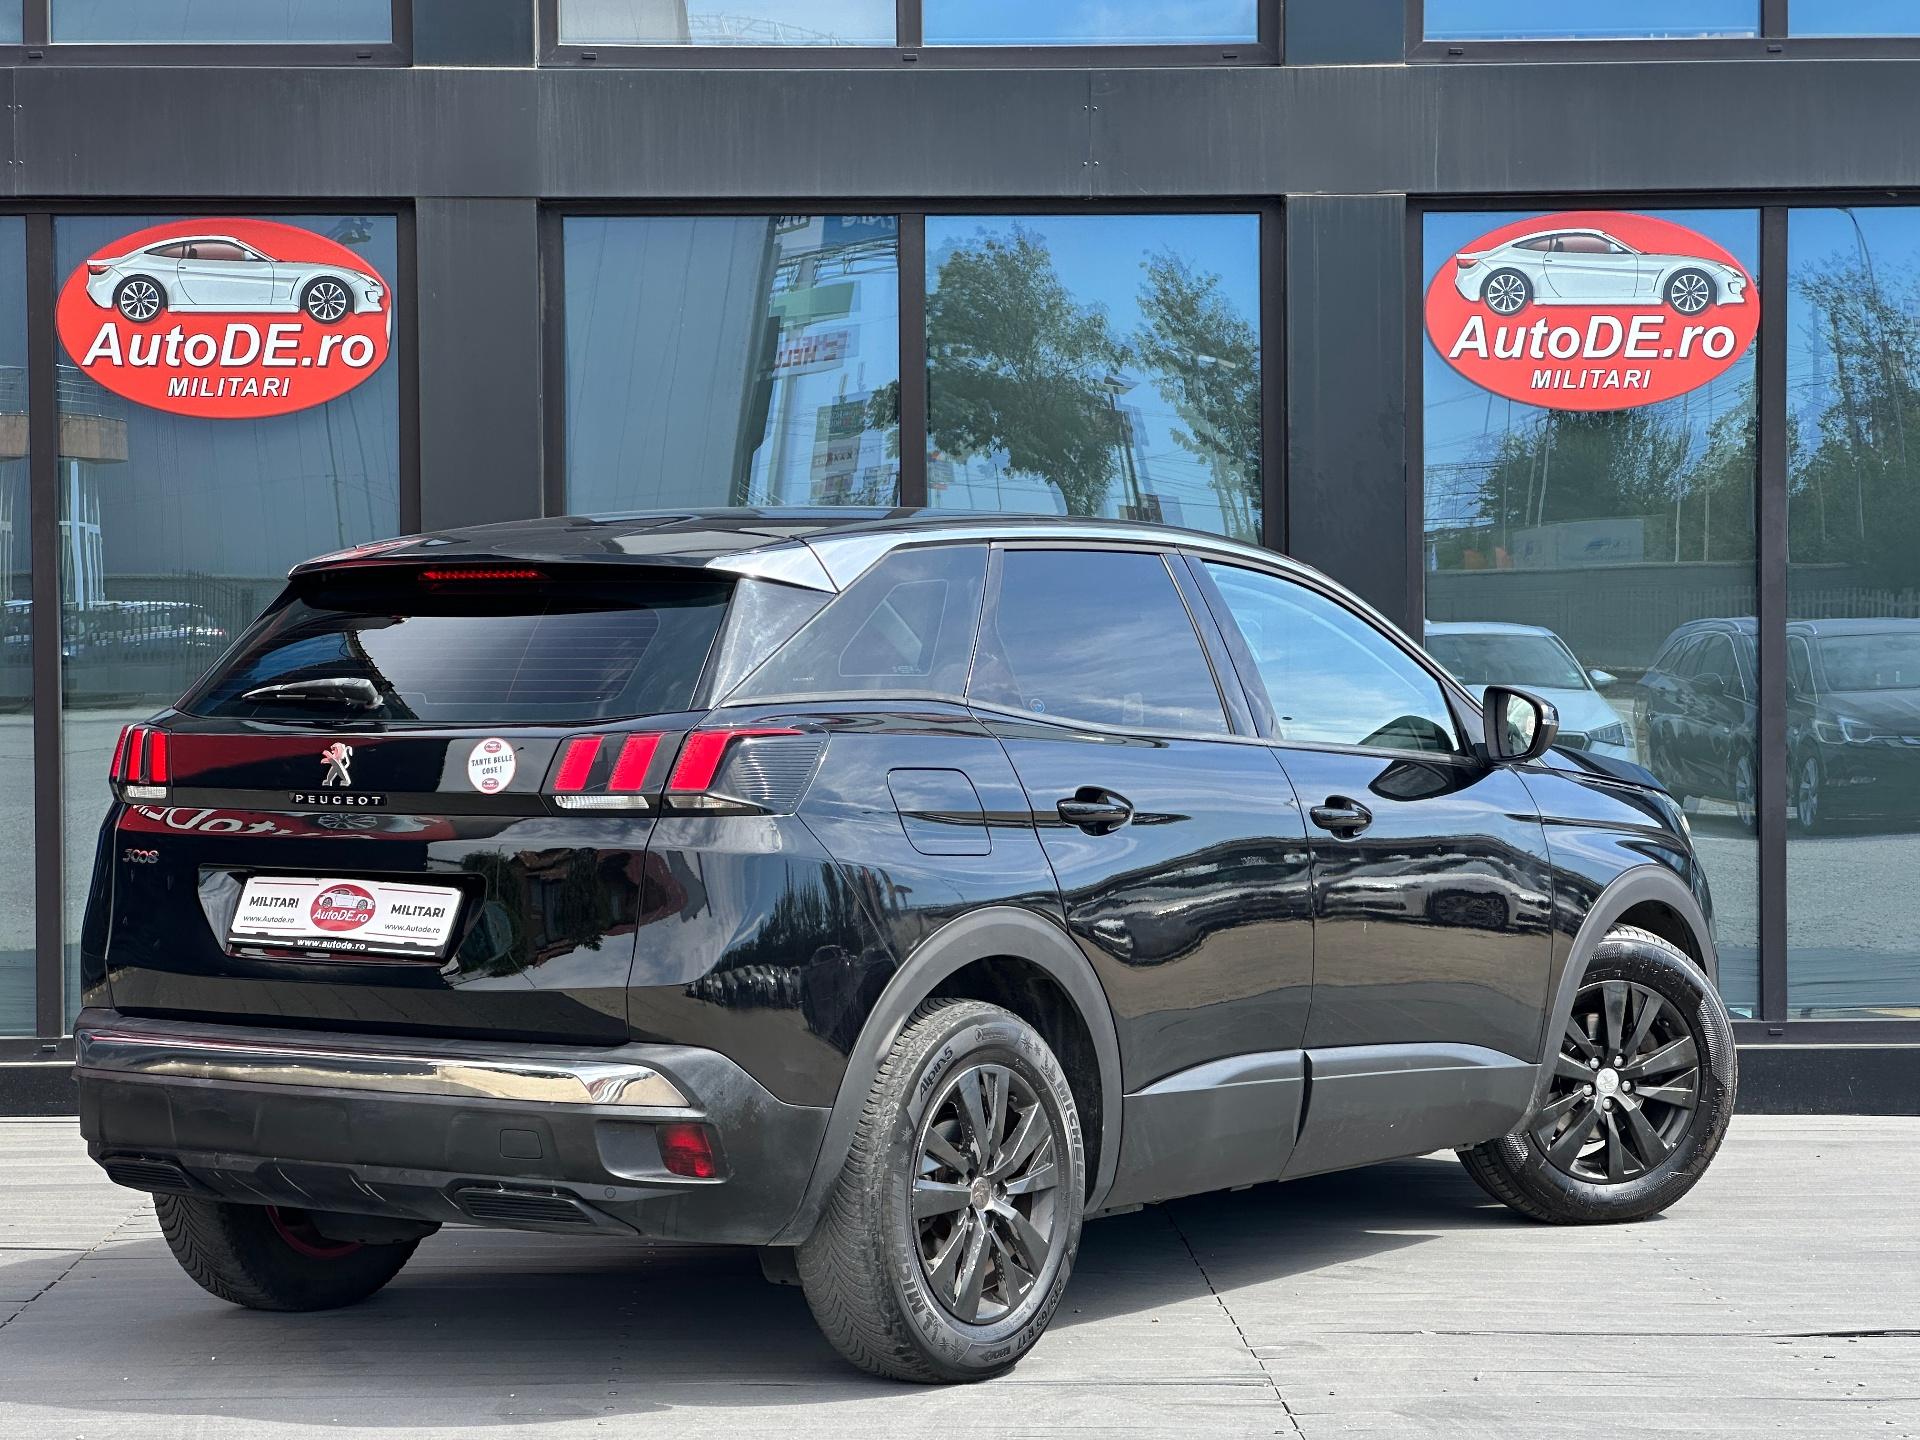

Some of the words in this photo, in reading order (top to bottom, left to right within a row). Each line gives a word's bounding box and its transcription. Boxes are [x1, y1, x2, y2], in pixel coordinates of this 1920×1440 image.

[1449, 315, 1736, 360] AutoDE.ro
[82, 322, 374, 369] AutoDE.ro
[1530, 369, 1651, 389] MILITARI
[167, 377, 291, 398] MILITARI
[471, 757, 492, 767] TANTE
[493, 754, 513, 764] BELLE
[295, 794, 381, 805] PEUGEOT
[122, 848, 160, 864] 3008
[249, 896, 300, 909] MILITARI
[312, 908, 369, 922] AutoDE.ro
[390, 903, 446, 918] MILITARI
[243, 915, 295, 924] www.Autode.ro
[384, 924, 441, 934] www.Autode.ro
[296, 939, 366, 951] www.autode.ro
